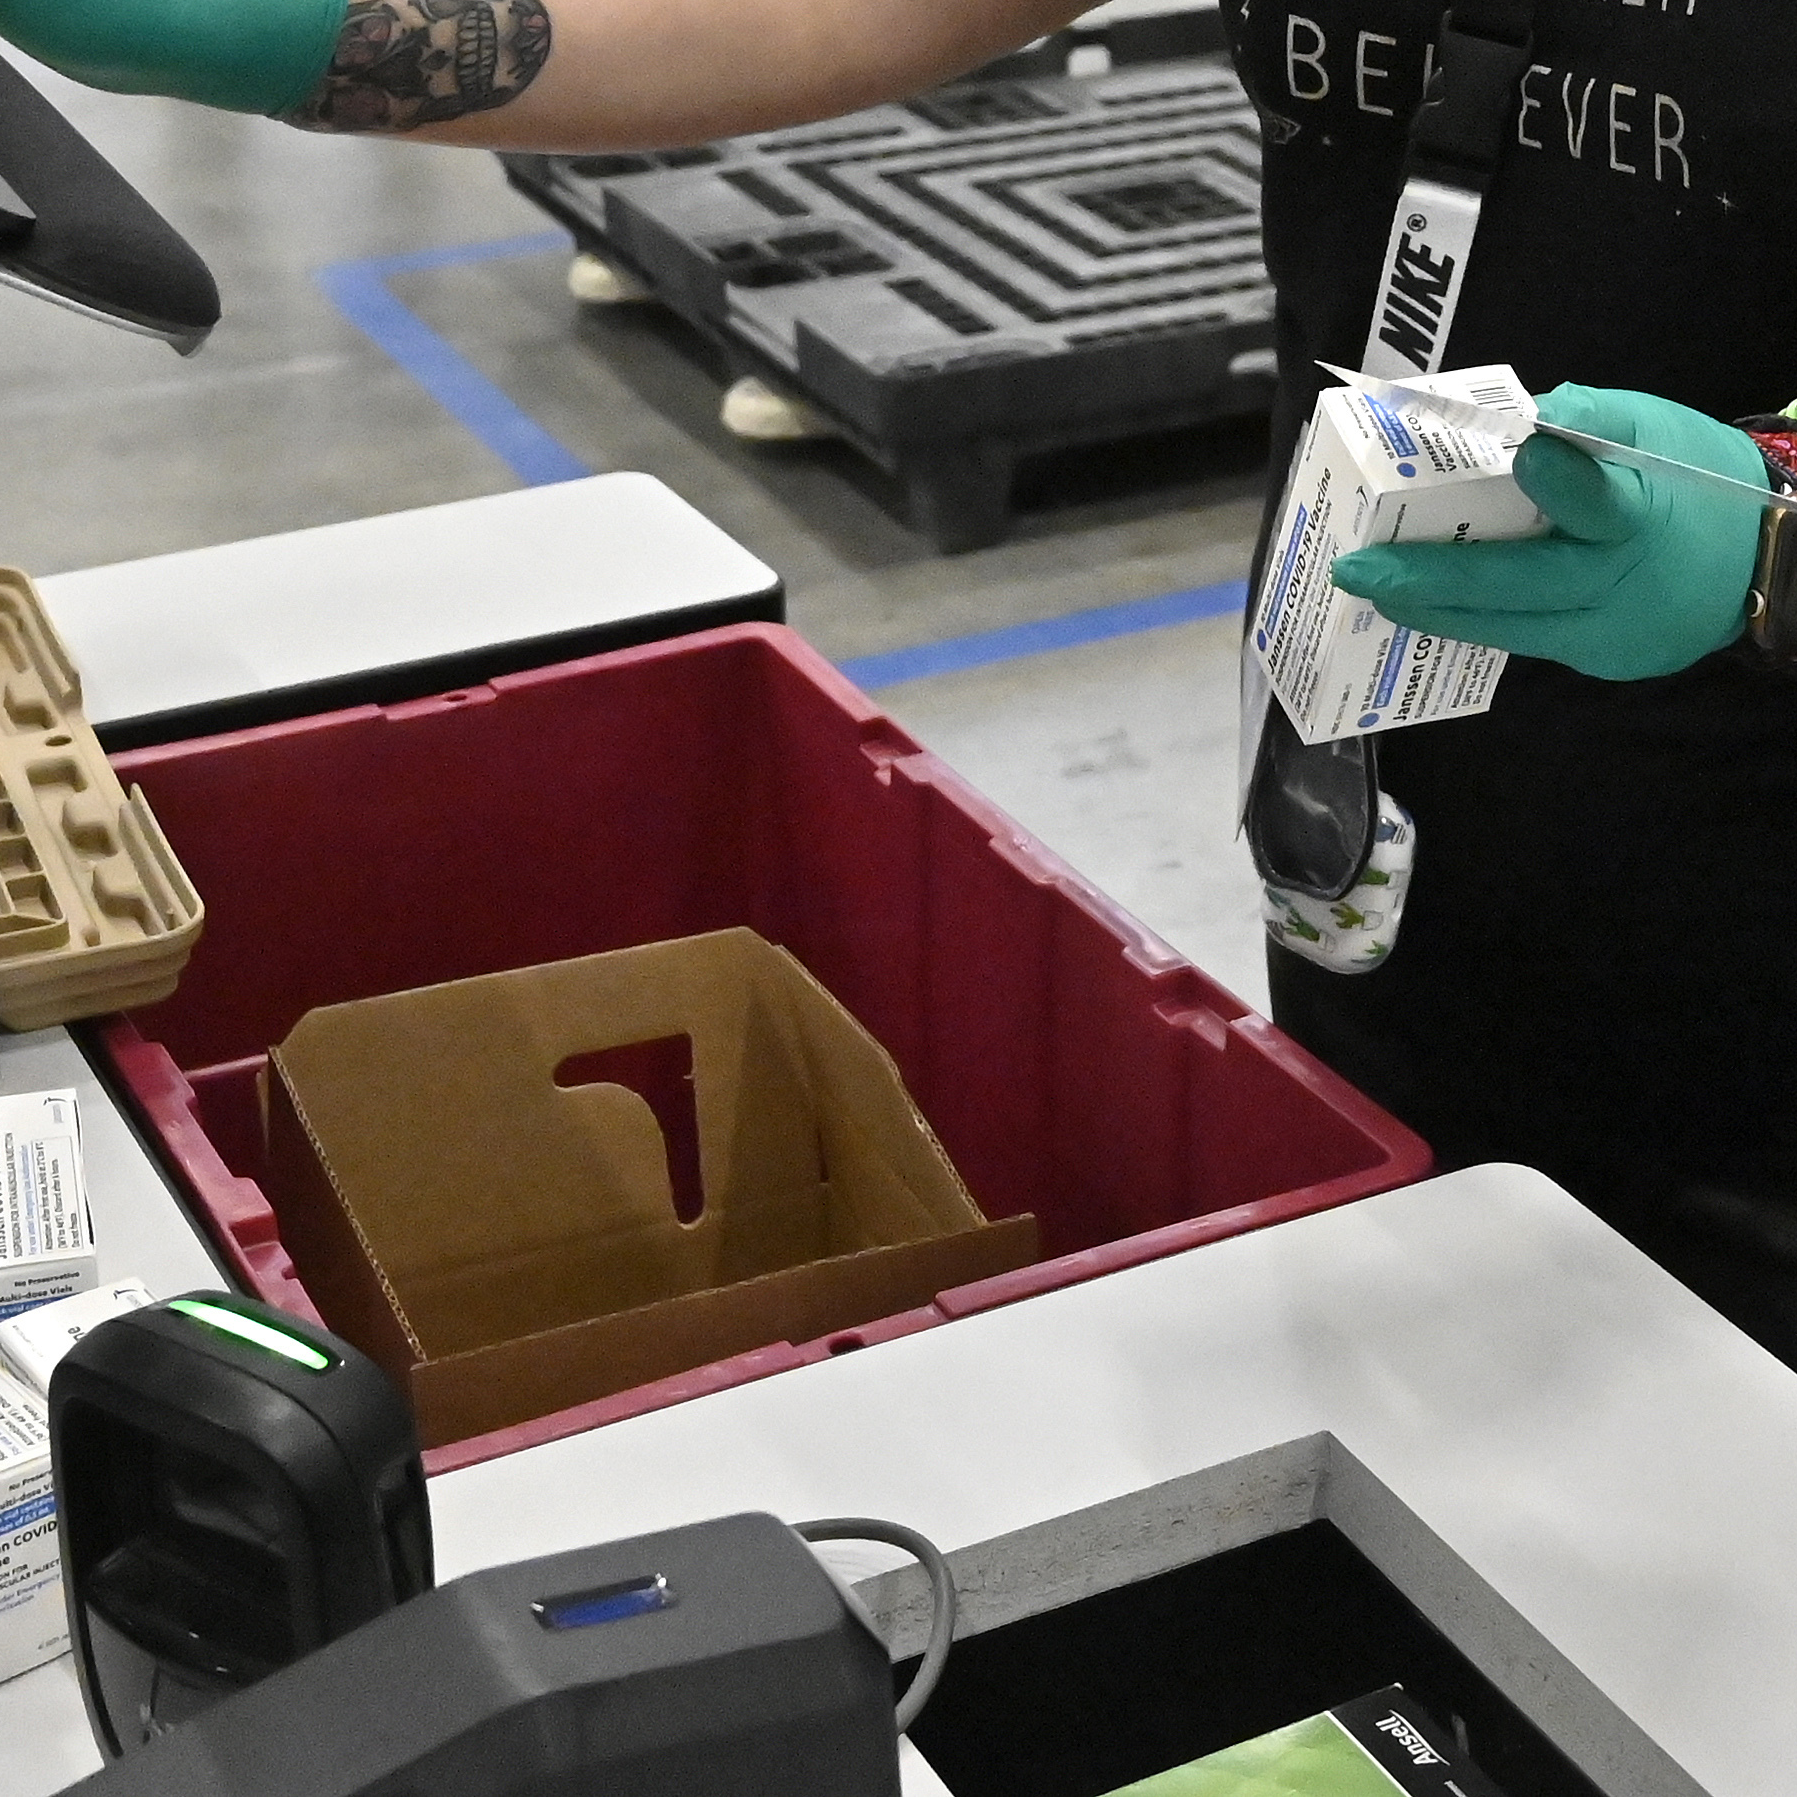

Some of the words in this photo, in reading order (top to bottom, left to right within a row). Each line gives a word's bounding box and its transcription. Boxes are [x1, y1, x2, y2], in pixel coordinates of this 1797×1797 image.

[1418, 432, 1446, 473] Janssen
[1431, 432, 1457, 471] Vaccine
[1268, 609, 1290, 675] Janssen
[1286, 530, 1312, 609] COVID-19
[1307, 467, 1331, 530] Vaccine
[1392, 664, 1425, 720] Janssen
[21, 1468, 52, 1486] Preserv
[13, 1518, 57, 1546] COVID
[12, 1563, 27, 1574] FOR
[32, 1557, 59, 1575] INJECT
[1375, 1715, 1438, 1765] Ansell
